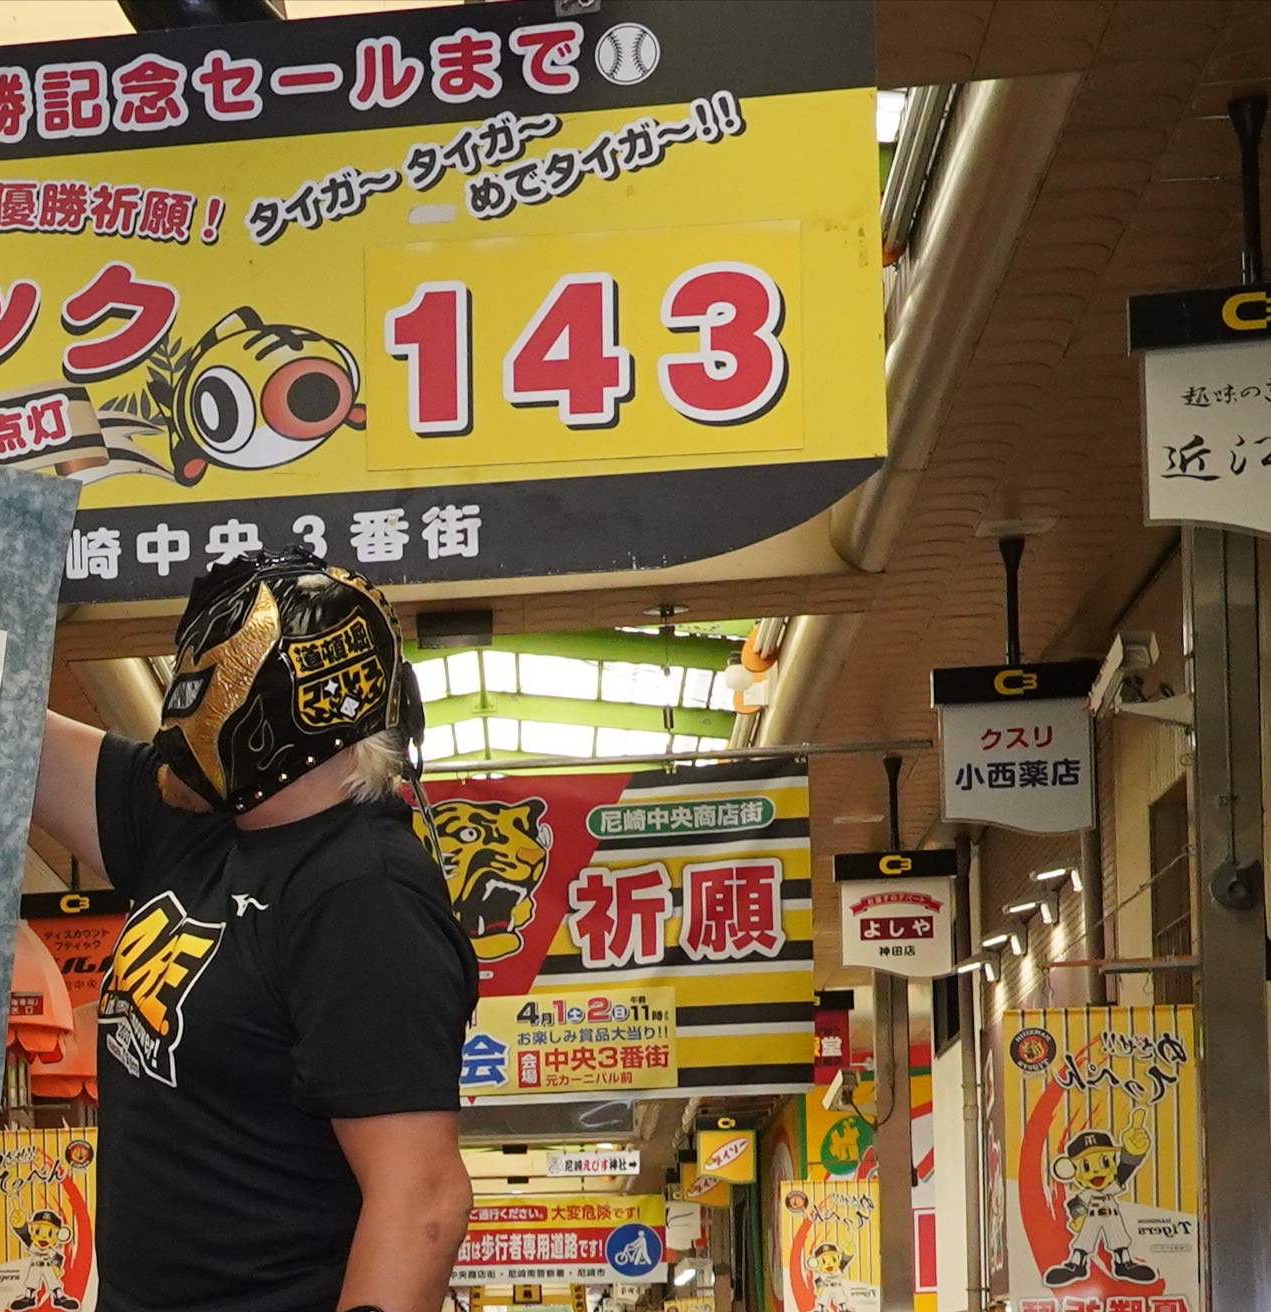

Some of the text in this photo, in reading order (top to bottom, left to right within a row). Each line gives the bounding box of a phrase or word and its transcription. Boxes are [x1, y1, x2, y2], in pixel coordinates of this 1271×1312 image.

[384, 262, 786, 437] 143
[980, 727, 1053, 750] クスリ
[955, 758, 1081, 792] 小西薬店
[599, 802, 765, 834] 尼崎中央商店街
[573, 863, 783, 963] 祈願
[864, 919, 931, 938] よしや
[879, 945, 916, 957] 神田店
[517, 1026, 668, 1045] お楽しみ賞品大当り!!
[521, 1052, 538, 1084] 会場
[545, 1046, 669, 1072] 中央3番街
[546, 1072, 633, 1086] 元カーニバル前
[551, 1205, 641, 1221] 大変危険です!
